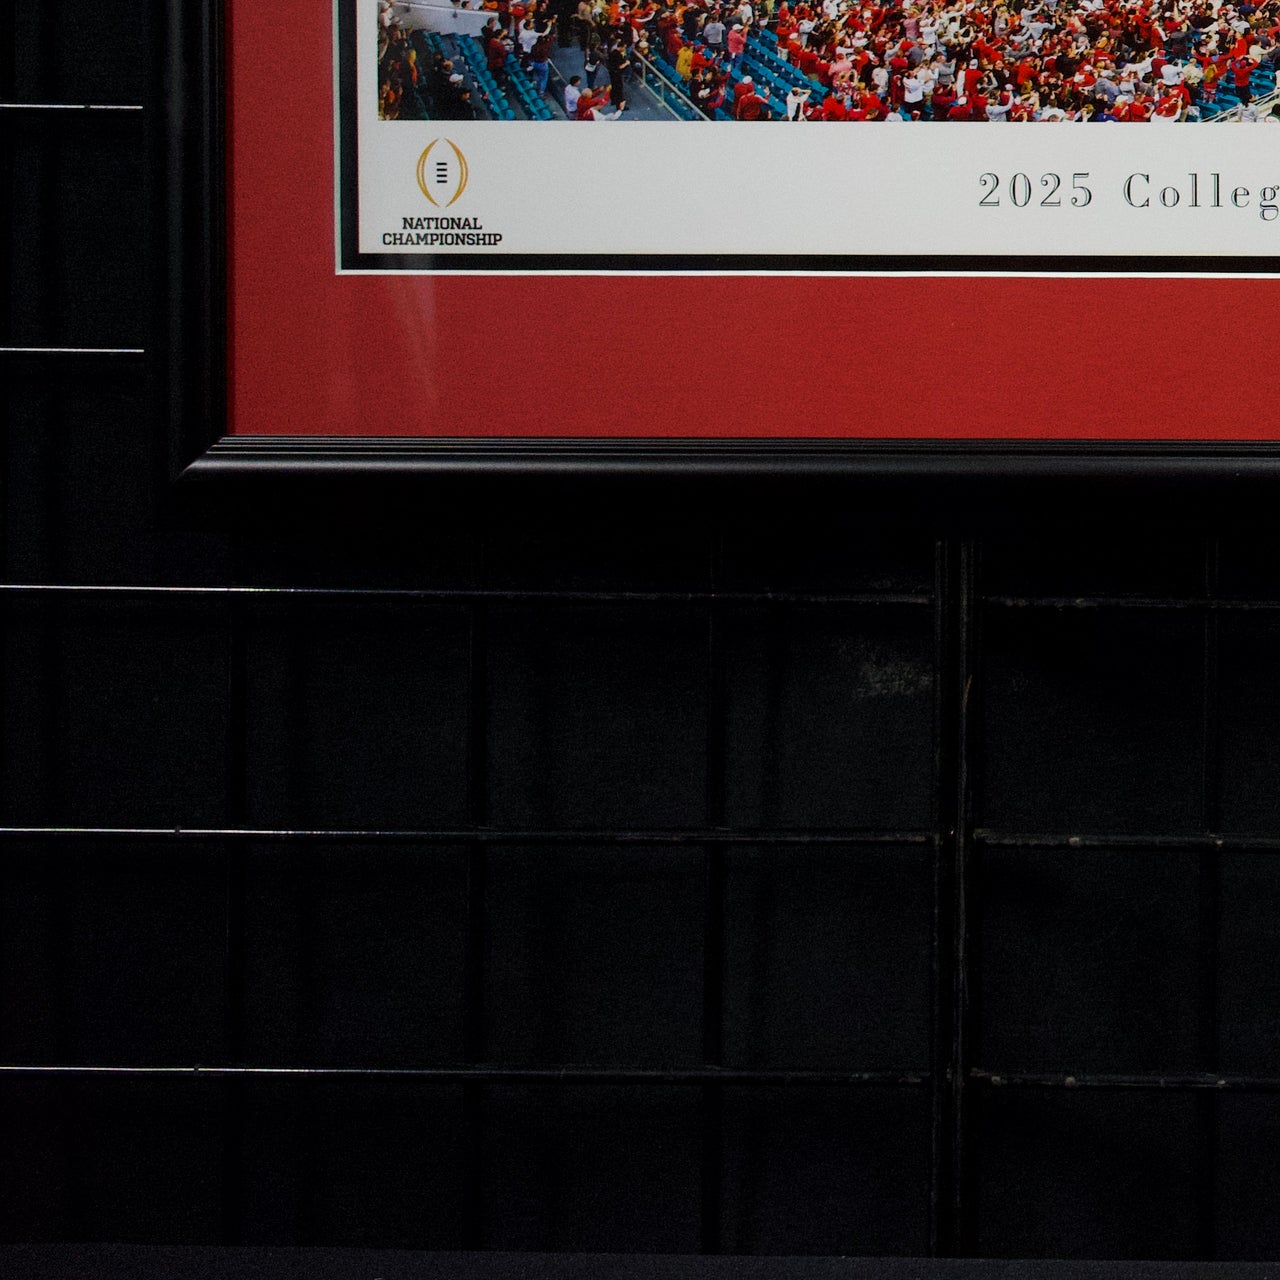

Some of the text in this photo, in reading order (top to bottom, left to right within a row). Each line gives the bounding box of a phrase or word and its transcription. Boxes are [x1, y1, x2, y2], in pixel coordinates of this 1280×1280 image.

[978, 172, 1092, 207] 2025
[402, 216, 483, 231] NATIONAL
[382, 232, 503, 247] CHAMPIONSHIP
